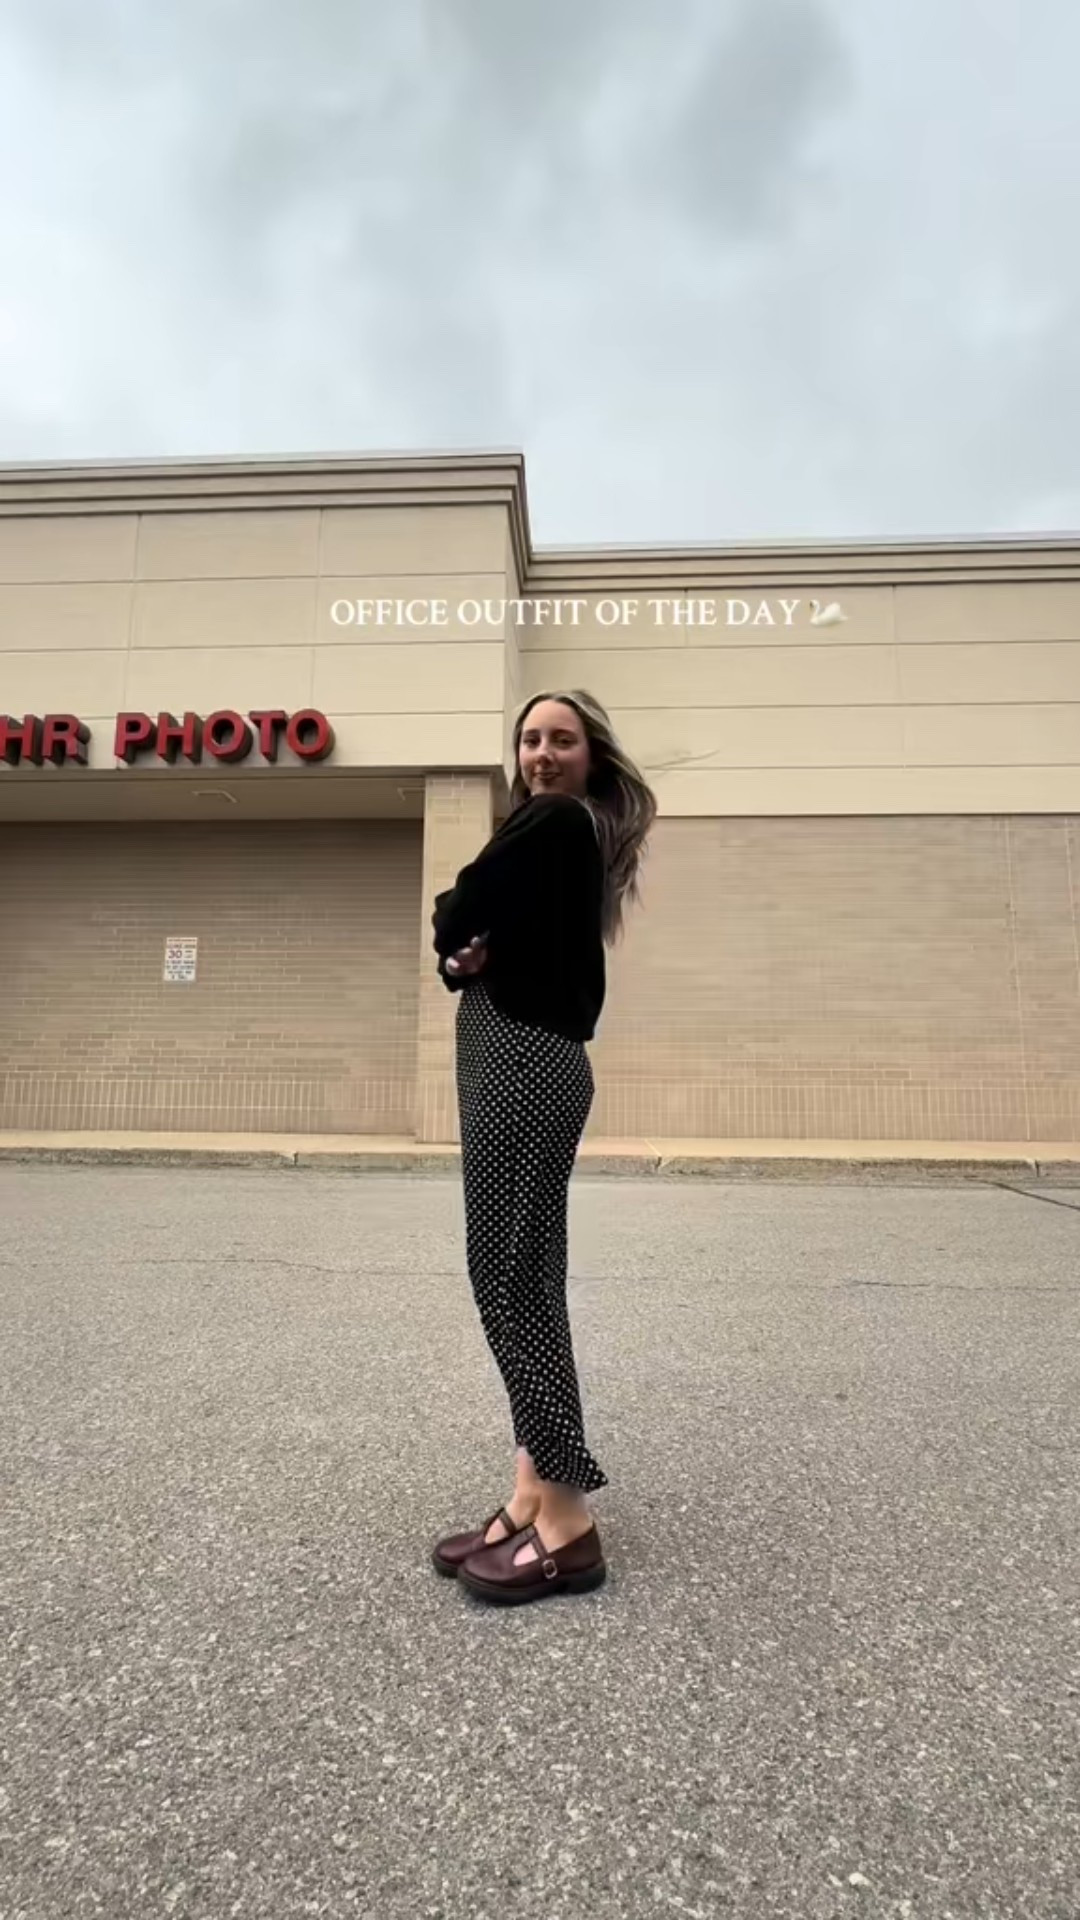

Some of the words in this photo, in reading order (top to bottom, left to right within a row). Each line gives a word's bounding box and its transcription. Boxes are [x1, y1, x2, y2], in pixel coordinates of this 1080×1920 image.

[0, 713, 89, 764] HR
[114, 708, 334, 764] PHOTO
[168, 949, 183, 959] 30
